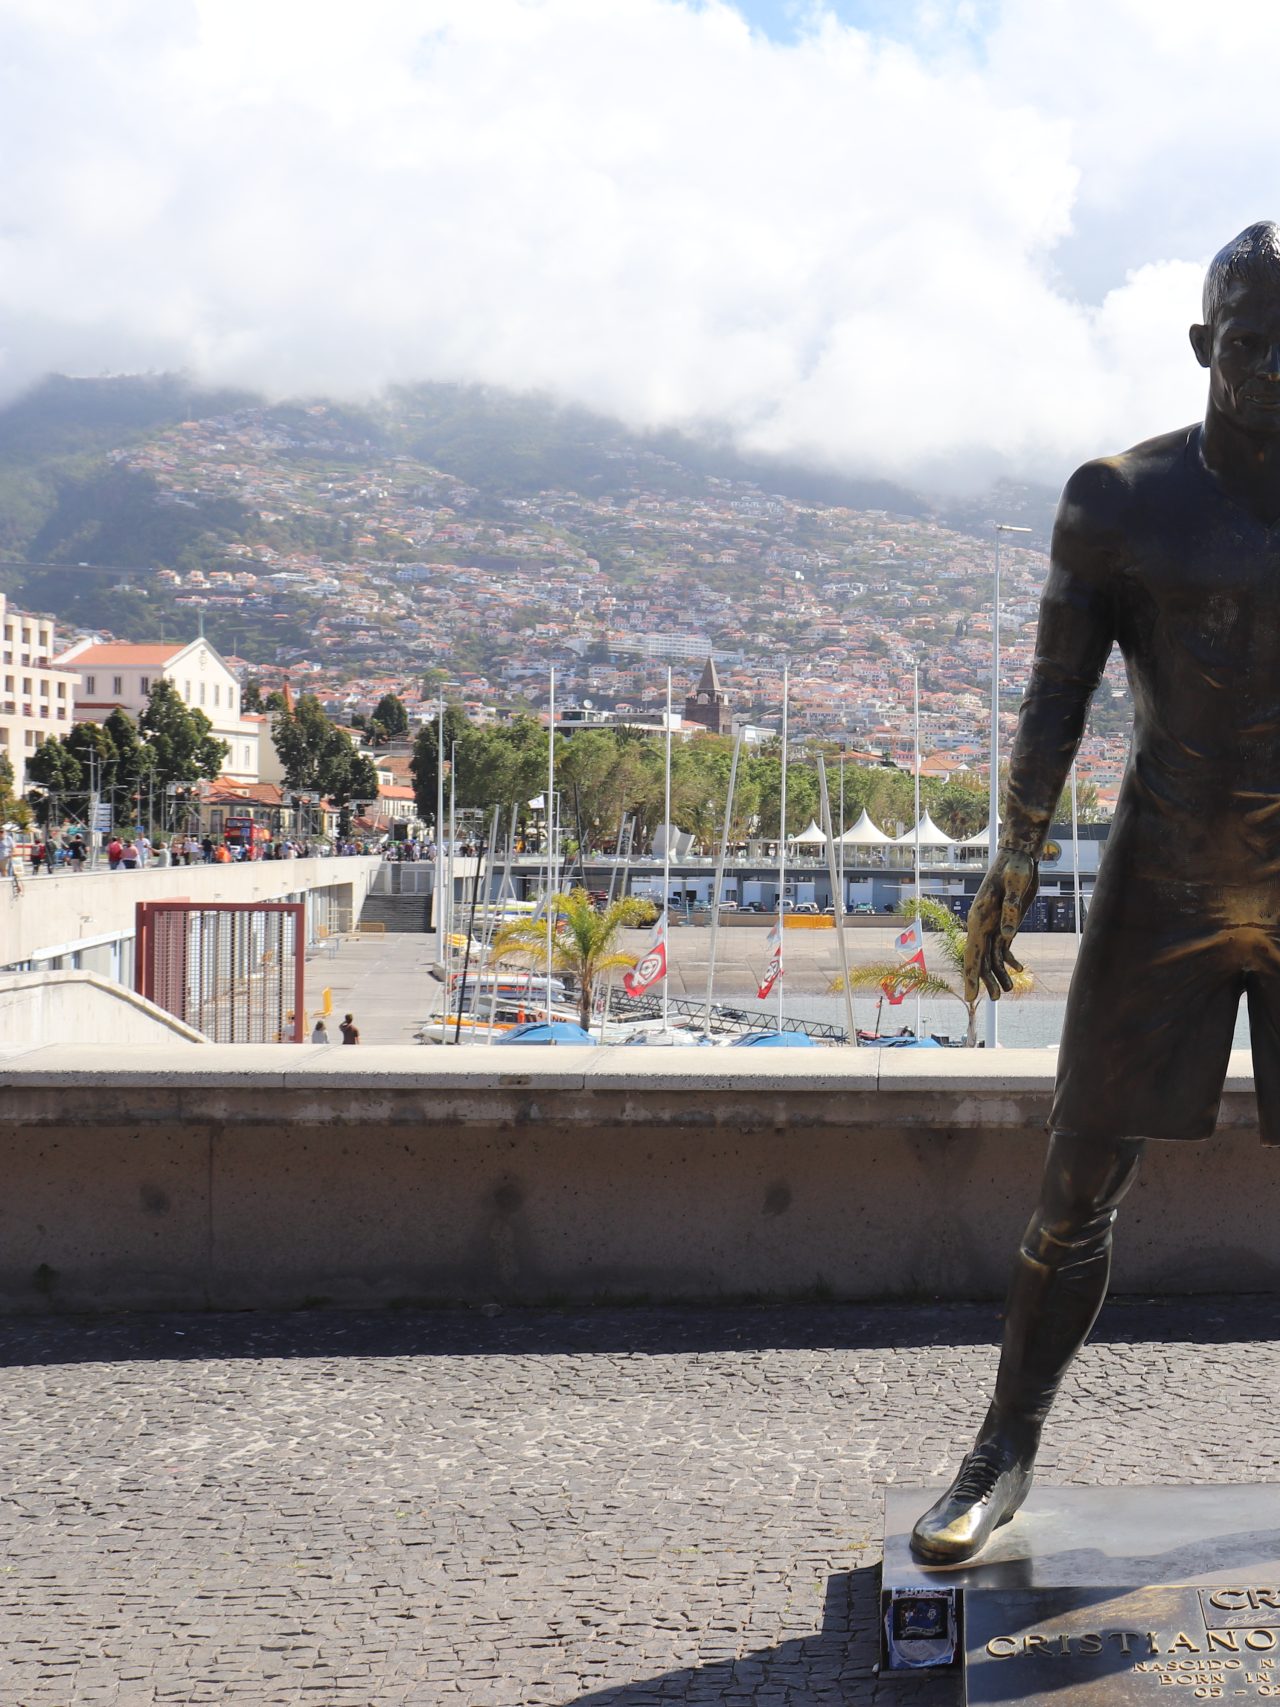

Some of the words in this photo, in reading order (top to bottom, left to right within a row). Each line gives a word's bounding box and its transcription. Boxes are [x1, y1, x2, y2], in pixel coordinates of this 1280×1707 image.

[985, 1629, 1277, 1658] CRISTIANO
[1132, 1659, 1242, 1673] NASCIDO
[1159, 1673, 1226, 1686] BORN
[1245, 1671, 1270, 1683] IN
[1194, 1687, 1223, 1698] 05
